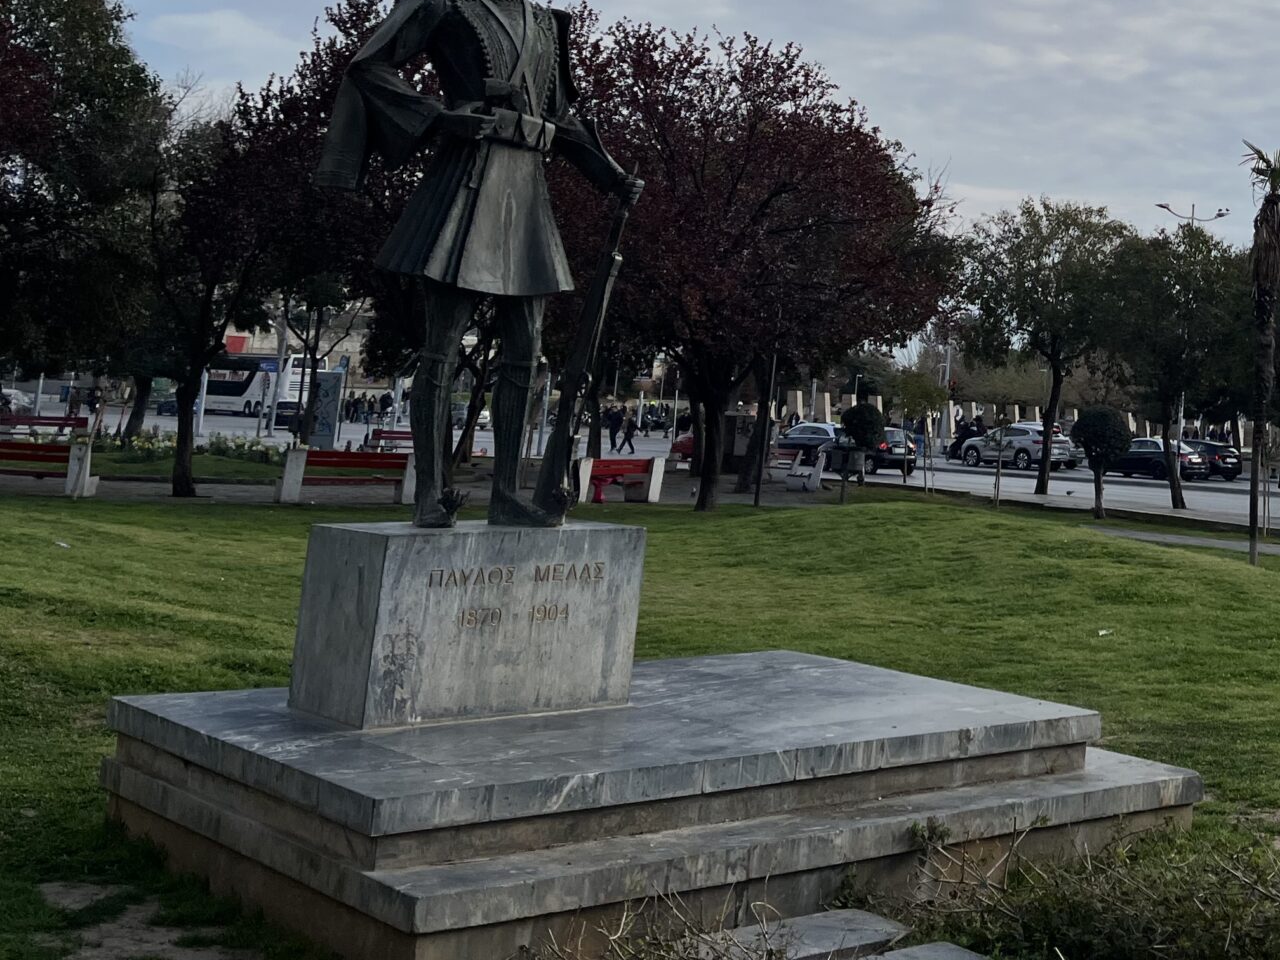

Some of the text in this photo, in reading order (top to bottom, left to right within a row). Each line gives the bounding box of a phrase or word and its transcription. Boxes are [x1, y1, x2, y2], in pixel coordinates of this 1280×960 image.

[428, 562, 605, 588] ΠΑΥΛΟΣ ΜΕΛΑΣ
[459, 607, 502, 628] 1870
[528, 603, 569, 623] 1904
